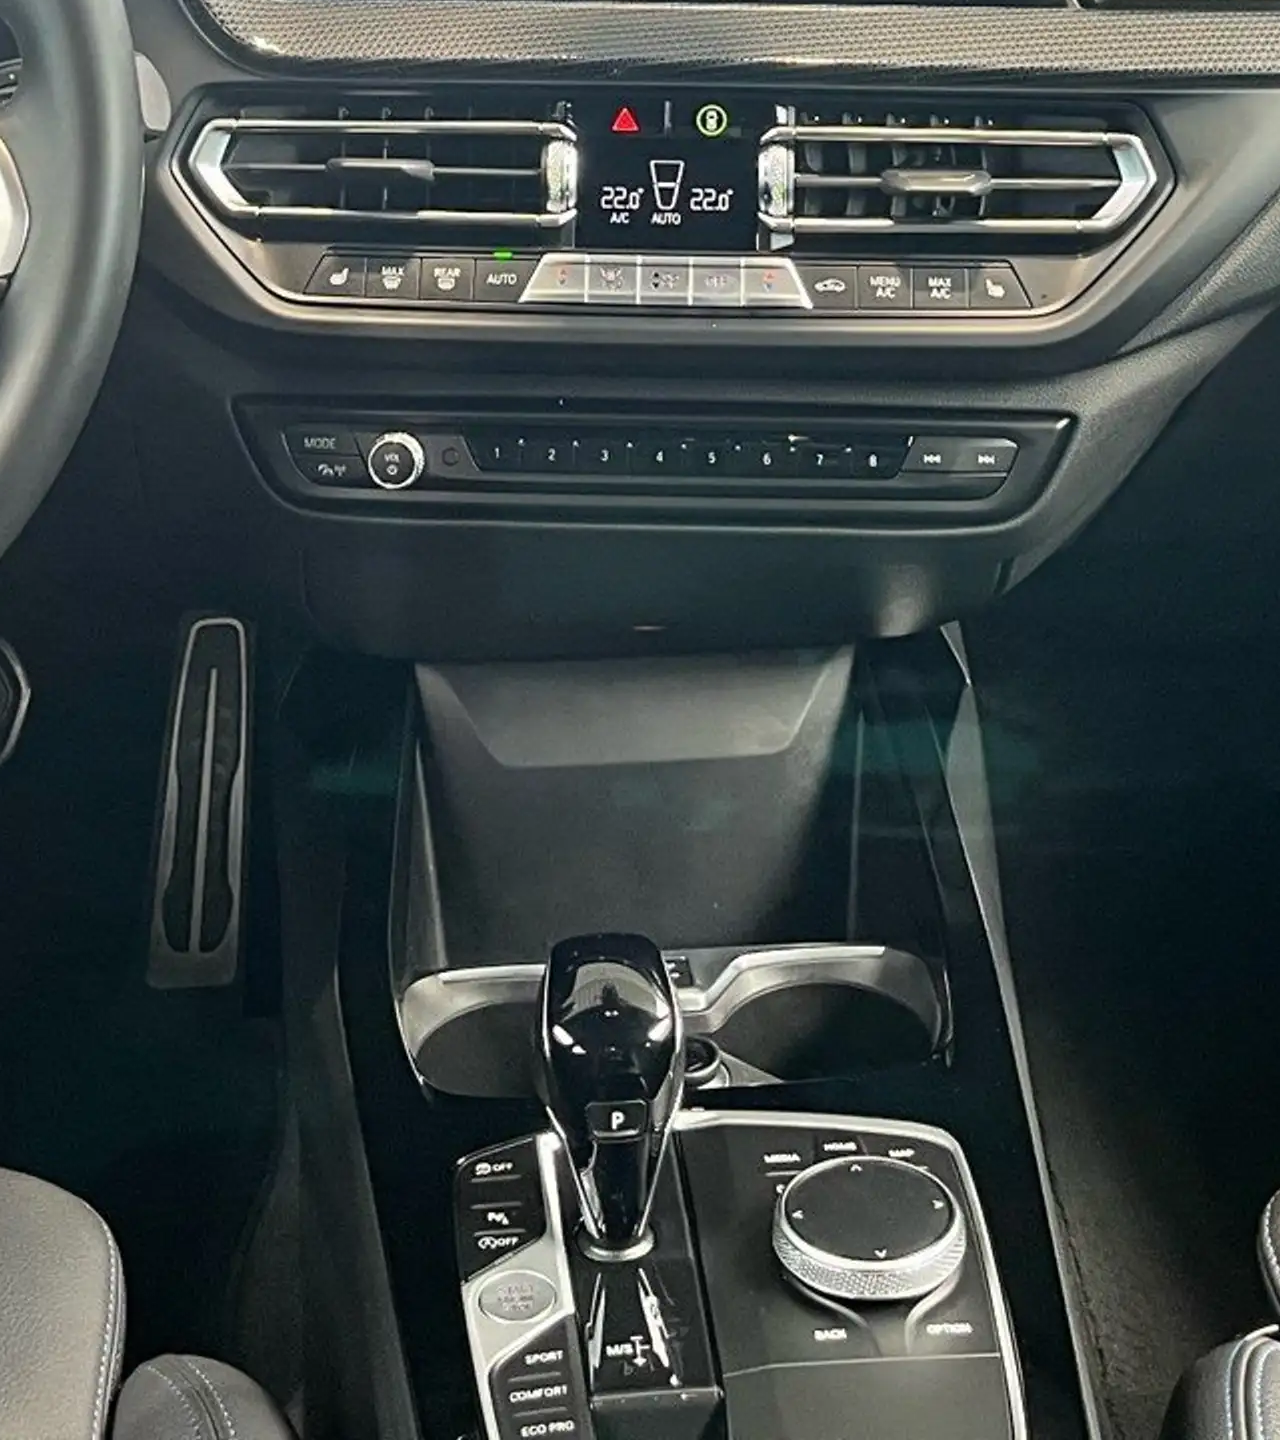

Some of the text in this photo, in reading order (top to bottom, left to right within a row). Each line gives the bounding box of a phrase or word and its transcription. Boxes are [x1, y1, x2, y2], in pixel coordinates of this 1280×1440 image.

[609, 212, 630, 225] A/C
[650, 212, 682, 226] AUTO
[381, 266, 405, 277] MAX
[433, 267, 462, 278] REAR
[485, 273, 518, 286] AUTO
[869, 276, 902, 288] MENU
[927, 276, 952, 288] MAX
[875, 287, 896, 299] A/C
[929, 287, 952, 300] A/C
[303, 437, 337, 449] MODE
[384, 453, 400, 463] VOL
[493, 447, 501, 459] 1
[547, 448, 556, 461] 2
[600, 449, 610, 462] 3
[655, 450, 664, 463] 4
[708, 451, 716, 464] 5
[762, 452, 772, 466] 6
[815, 453, 824, 466] 7
[868, 454, 878, 467] 8
[611, 1111, 625, 1130] P
[496, 1237, 519, 1247] OFF
[523, 1349, 564, 1365] SPORT
[605, 1344, 634, 1358] M/S
[508, 1384, 569, 1403] COMFORT
[520, 1419, 576, 1438] ECO PRO
